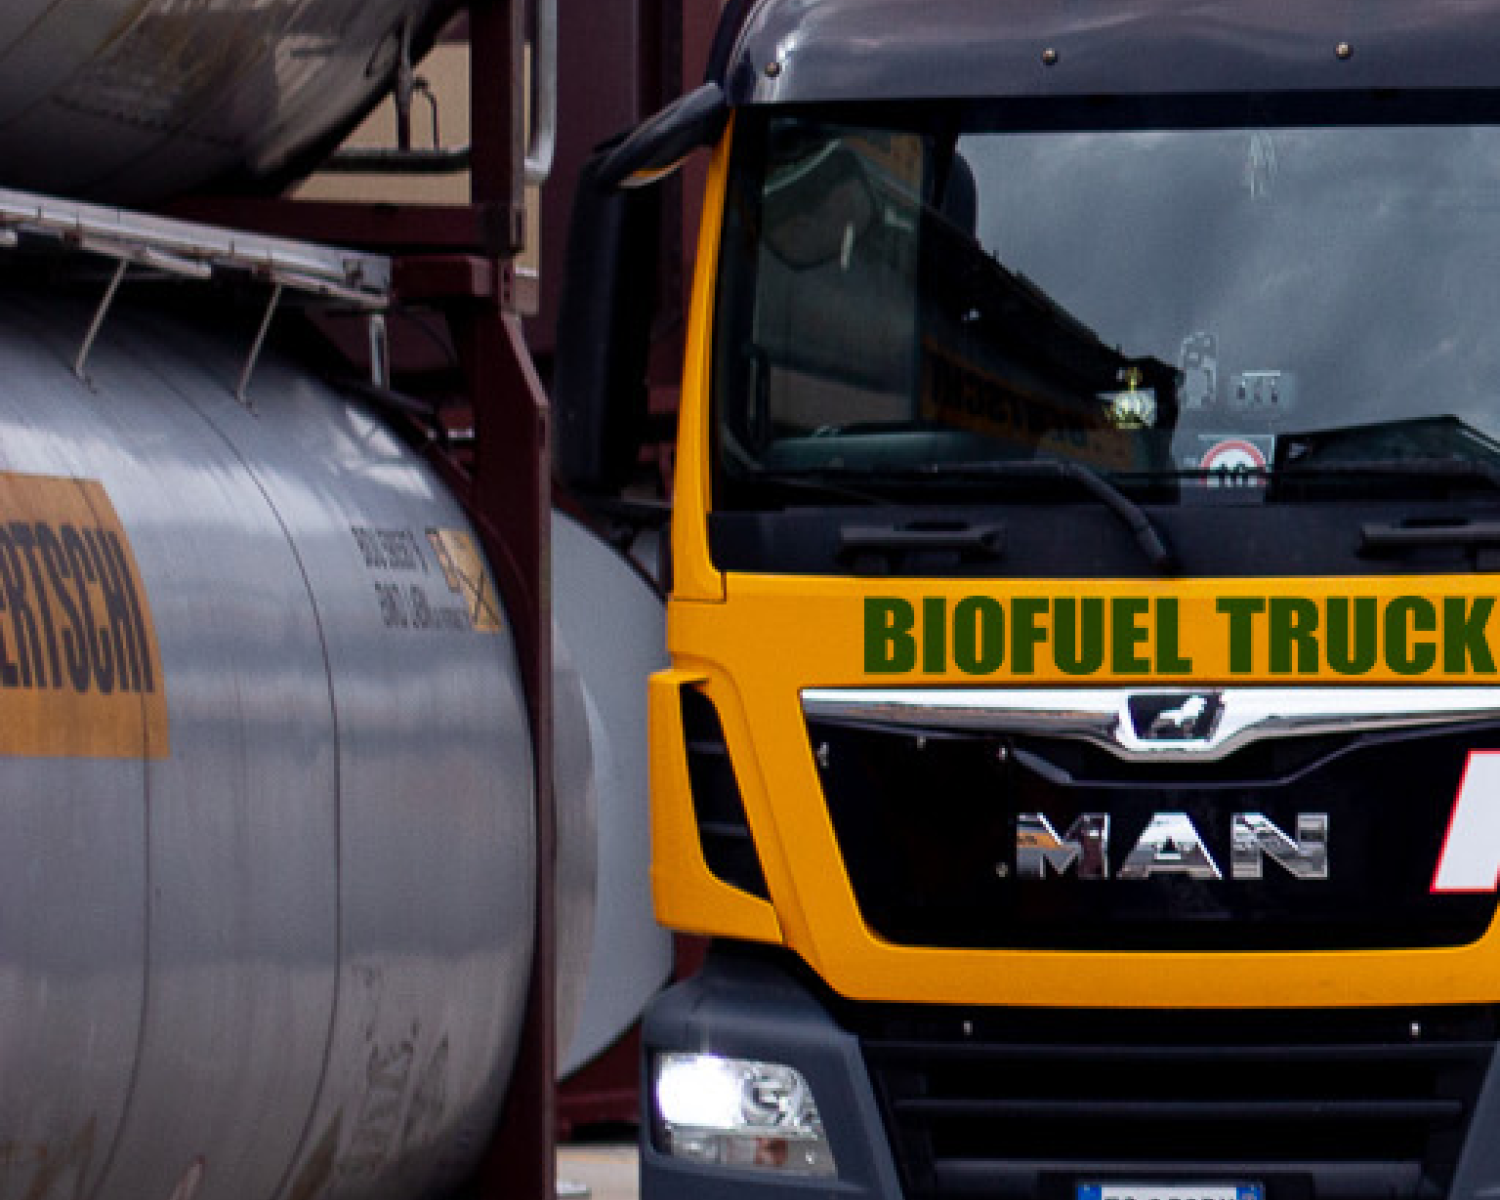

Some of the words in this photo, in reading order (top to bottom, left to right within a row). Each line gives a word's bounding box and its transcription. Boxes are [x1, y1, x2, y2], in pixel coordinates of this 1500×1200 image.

[863, 594, 1192, 676] BIOFUEL
[1215, 594, 1497, 676] TRUCK
[1015, 811, 1330, 880] MAN
